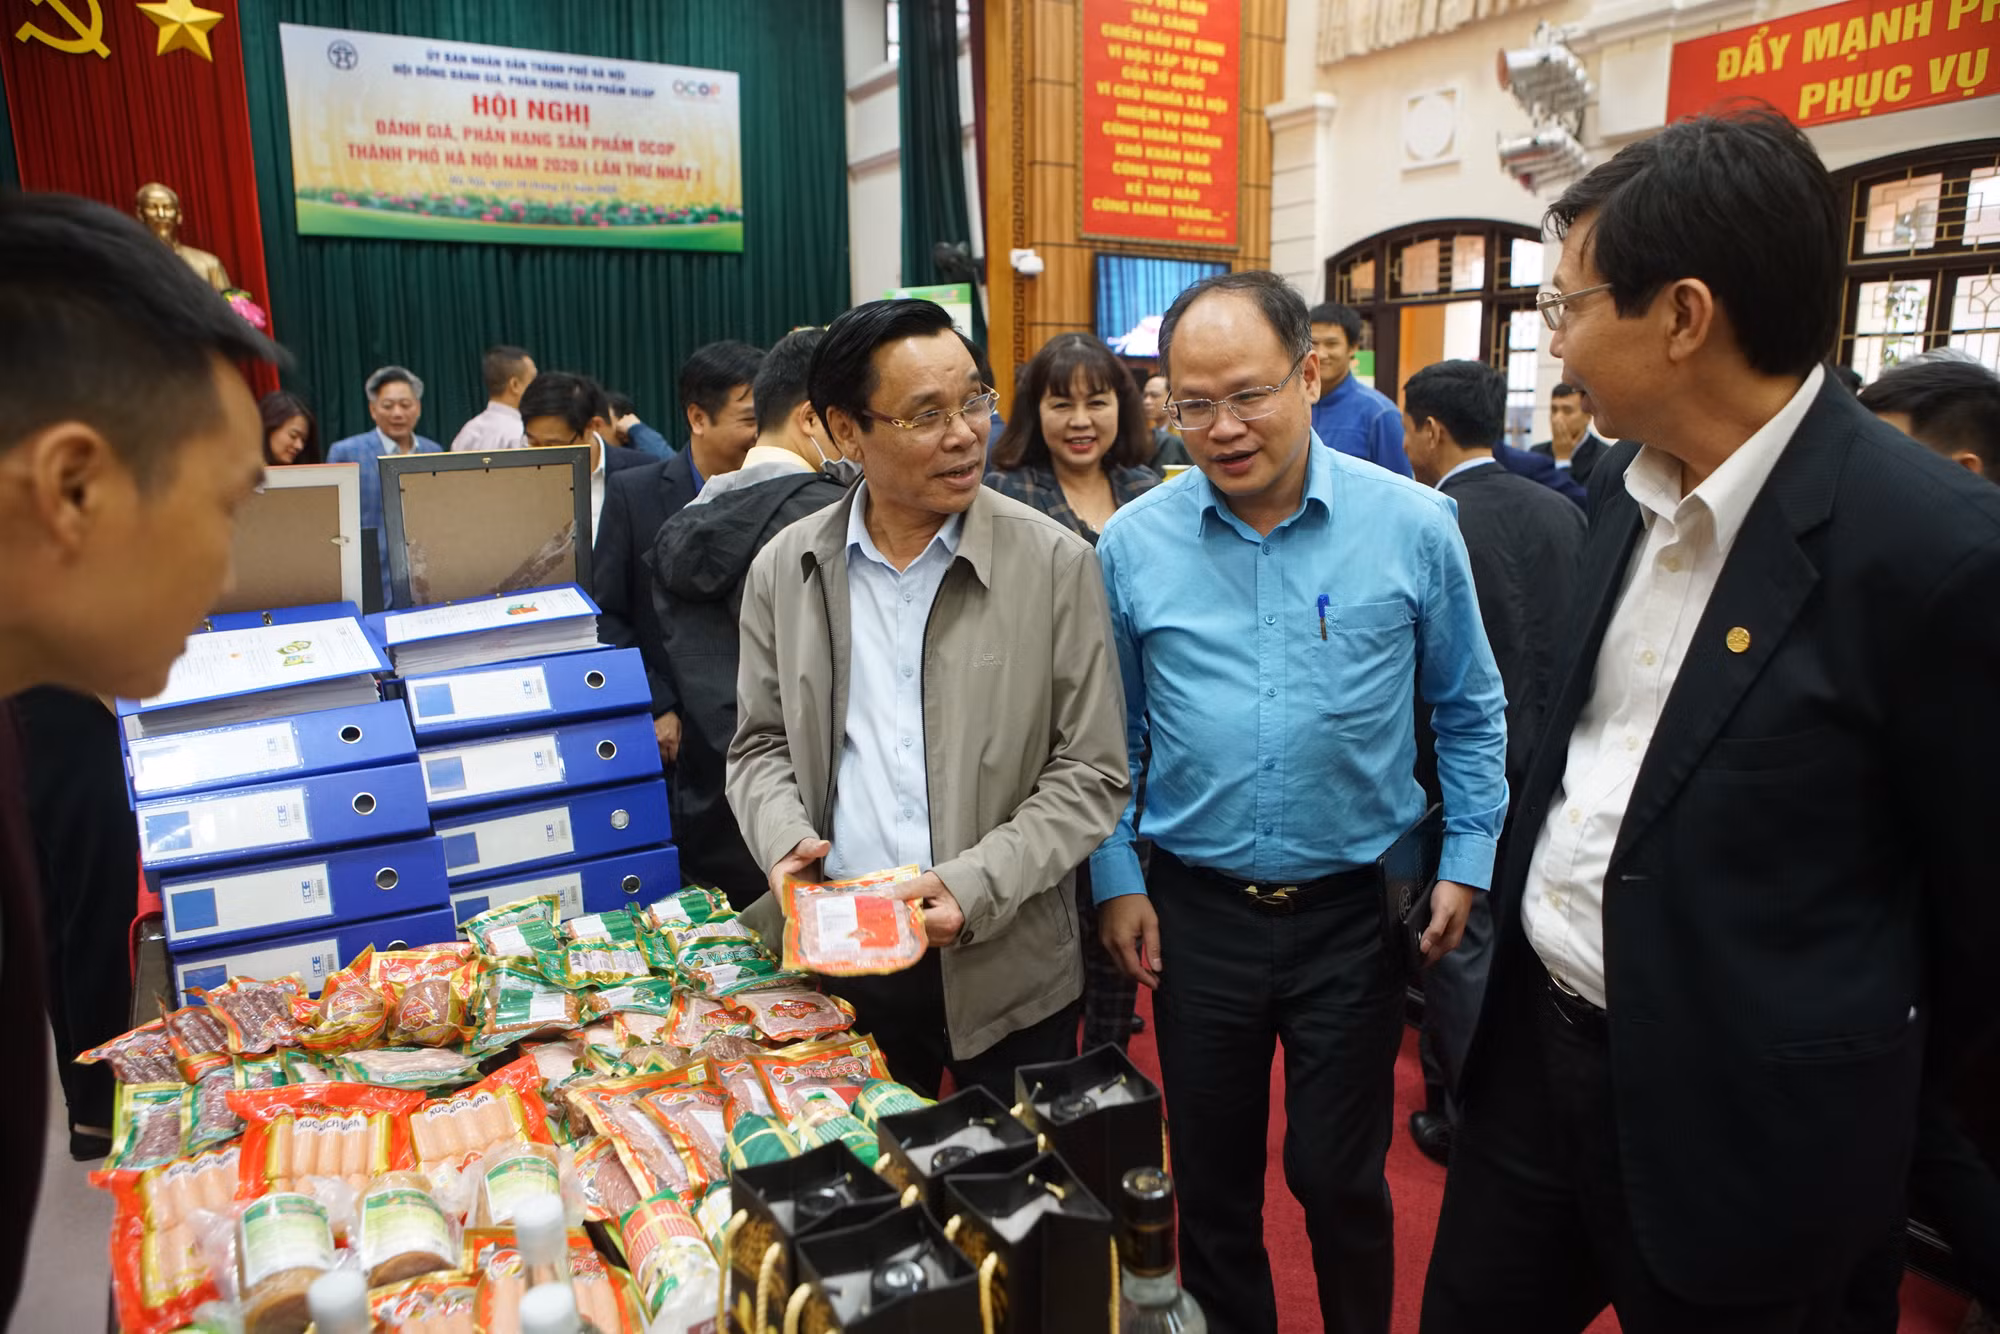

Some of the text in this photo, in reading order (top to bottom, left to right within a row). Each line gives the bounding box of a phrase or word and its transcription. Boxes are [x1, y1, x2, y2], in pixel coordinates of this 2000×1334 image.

[1716, 26, 1792, 83] ĐẨY
[1802, 0, 1933, 63] MẠNH
[1798, 48, 1990, 120] PHỤC VỤ
[473, 91, 590, 130] HỘI NGHỊ
[376, 119, 674, 155] ĐÁNH GIÁ, PHÂN HẠNG SẢN PHẨM OCOP
[348, 143, 402, 162] THÀNH
[407, 145, 440, 164] PHỐ
[445, 149, 466, 166] HÀ
[470, 152, 498, 169] NỘI
[503, 153, 538, 170] NĂM
[543, 157, 579, 174] 2020
[626, 162, 652, 178] THỨ
